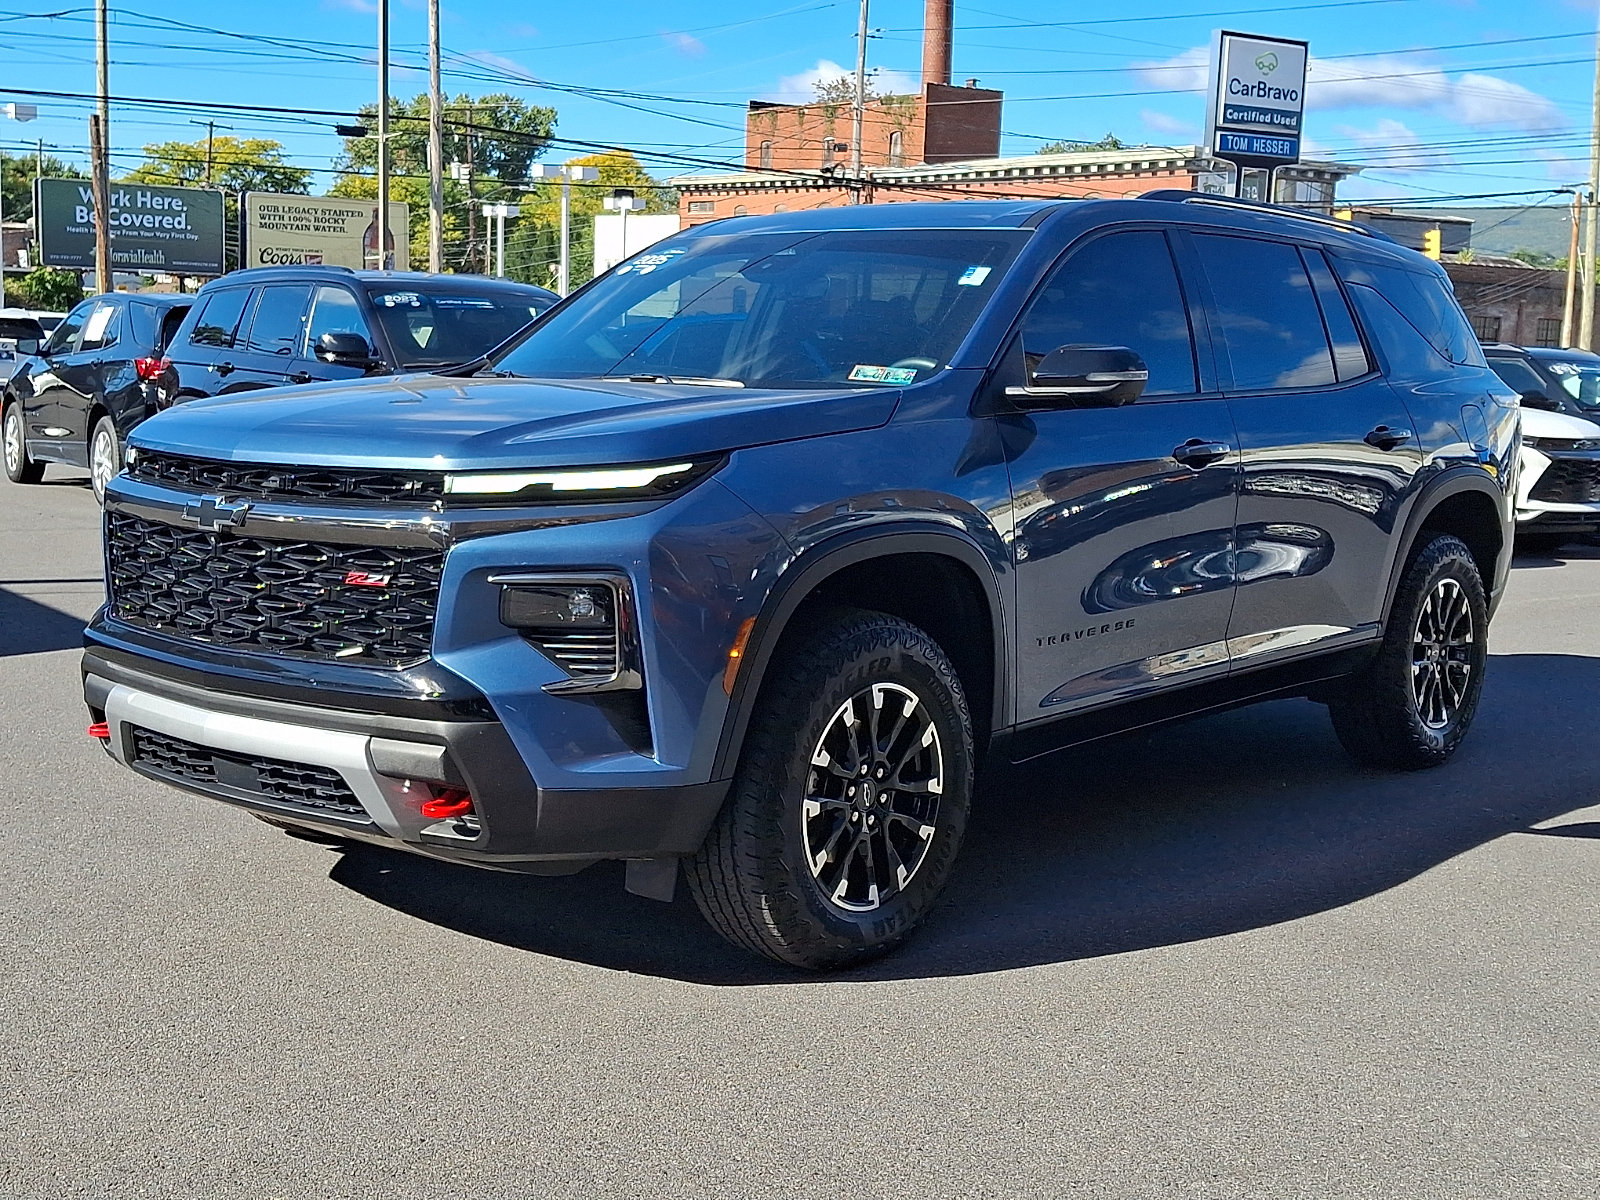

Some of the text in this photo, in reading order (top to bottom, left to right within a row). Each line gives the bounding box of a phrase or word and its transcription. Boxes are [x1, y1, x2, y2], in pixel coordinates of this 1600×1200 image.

[1229, 77, 1299, 102] CarBravo
[1226, 108, 1297, 126] Certified Used
[1227, 135, 1290, 155] TOM HESSER
[78, 186, 188, 212] Wrk Here.
[75, 205, 192, 231] Be Covered.
[258, 204, 364, 218] OUR LEGACY STARTED
[258, 213, 347, 226] WITH 100% ROCKY
[66, 226, 89, 234] Health
[122, 229, 139, 237] From
[139, 230, 155, 238] Your
[155, 231, 170, 240] Very
[171, 232, 185, 240] First
[258, 221, 349, 234] MOUNTAIN WATER.
[258, 246, 304, 266] Coors
[1035, 618, 1136, 647] TRAVERSE
